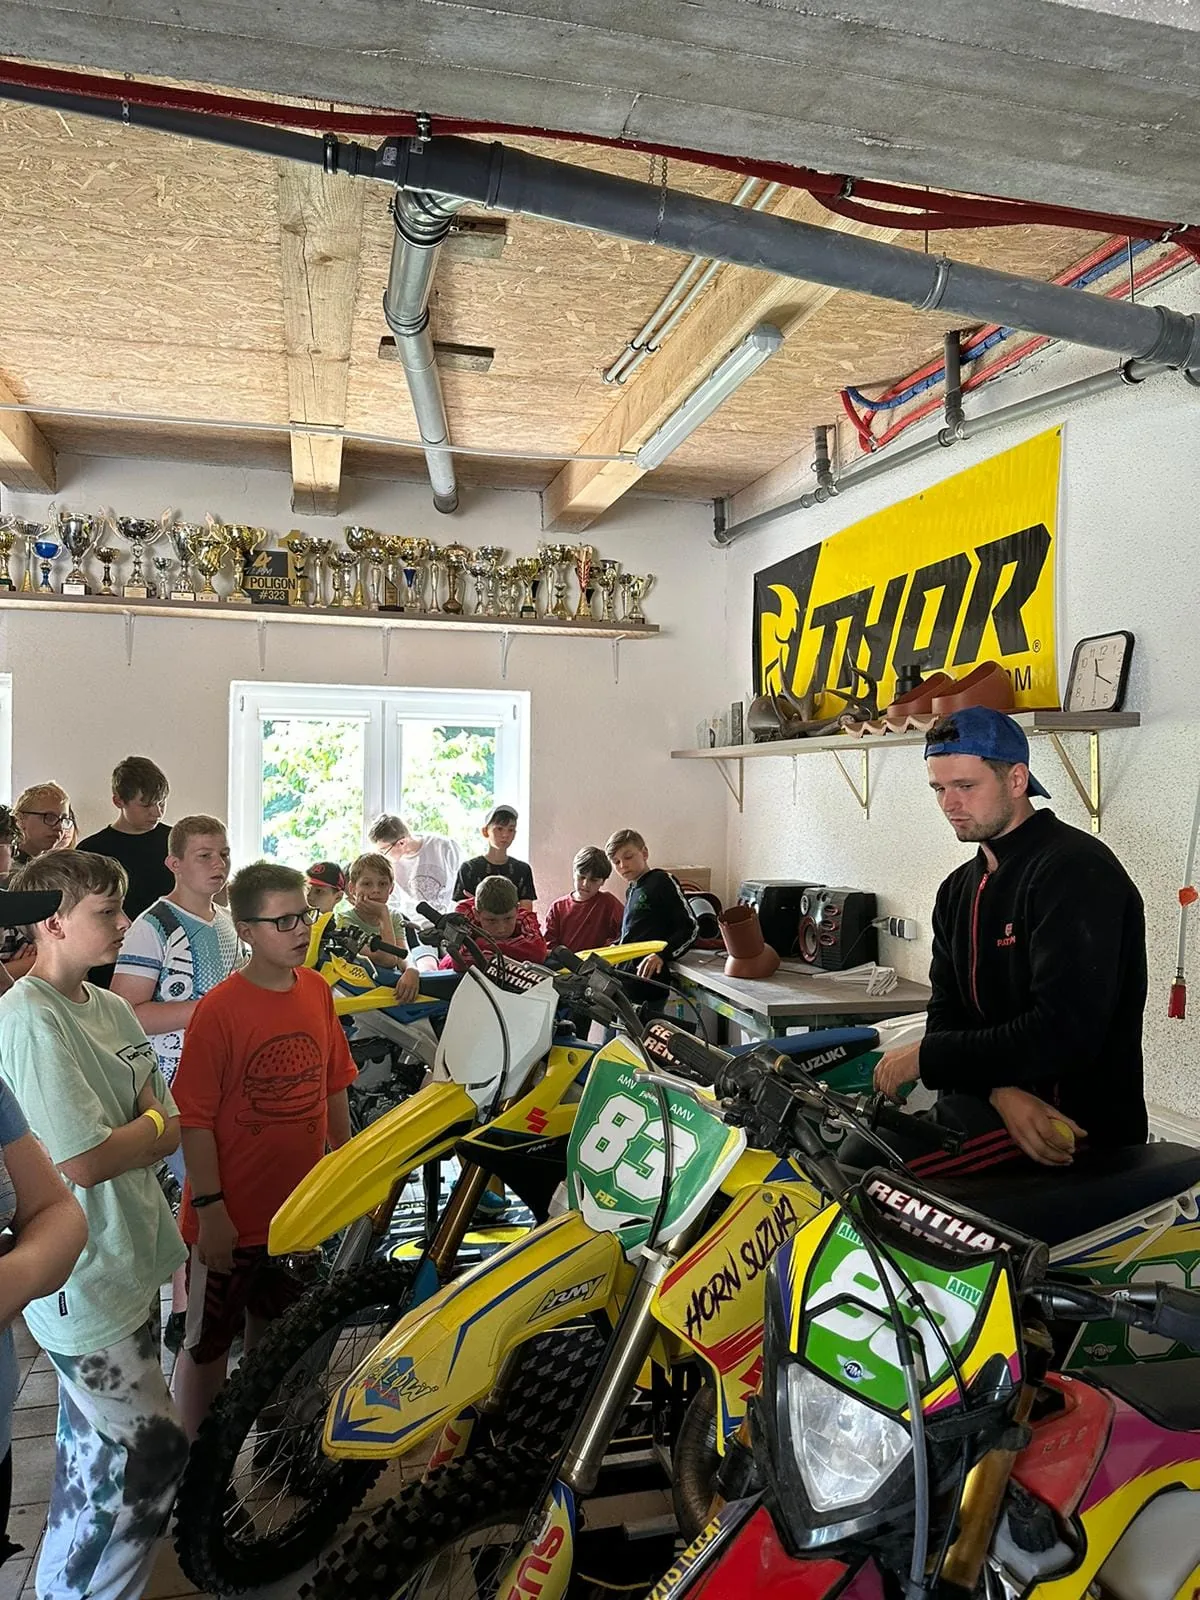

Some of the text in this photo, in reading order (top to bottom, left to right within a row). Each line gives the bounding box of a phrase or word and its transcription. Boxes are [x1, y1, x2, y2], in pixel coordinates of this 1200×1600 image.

[250, 577, 296, 590] POLIGON
[258, 590, 286, 601] #323
[810, 523, 1052, 697] THOR
[486, 966, 533, 989] RNTHA
[491, 957, 543, 983] RNTHAL
[801, 1046, 848, 1072] UZUKI
[669, 1103, 695, 1122] AMV
[578, 1093, 699, 1202] 83
[683, 1246, 742, 1341] HORN
